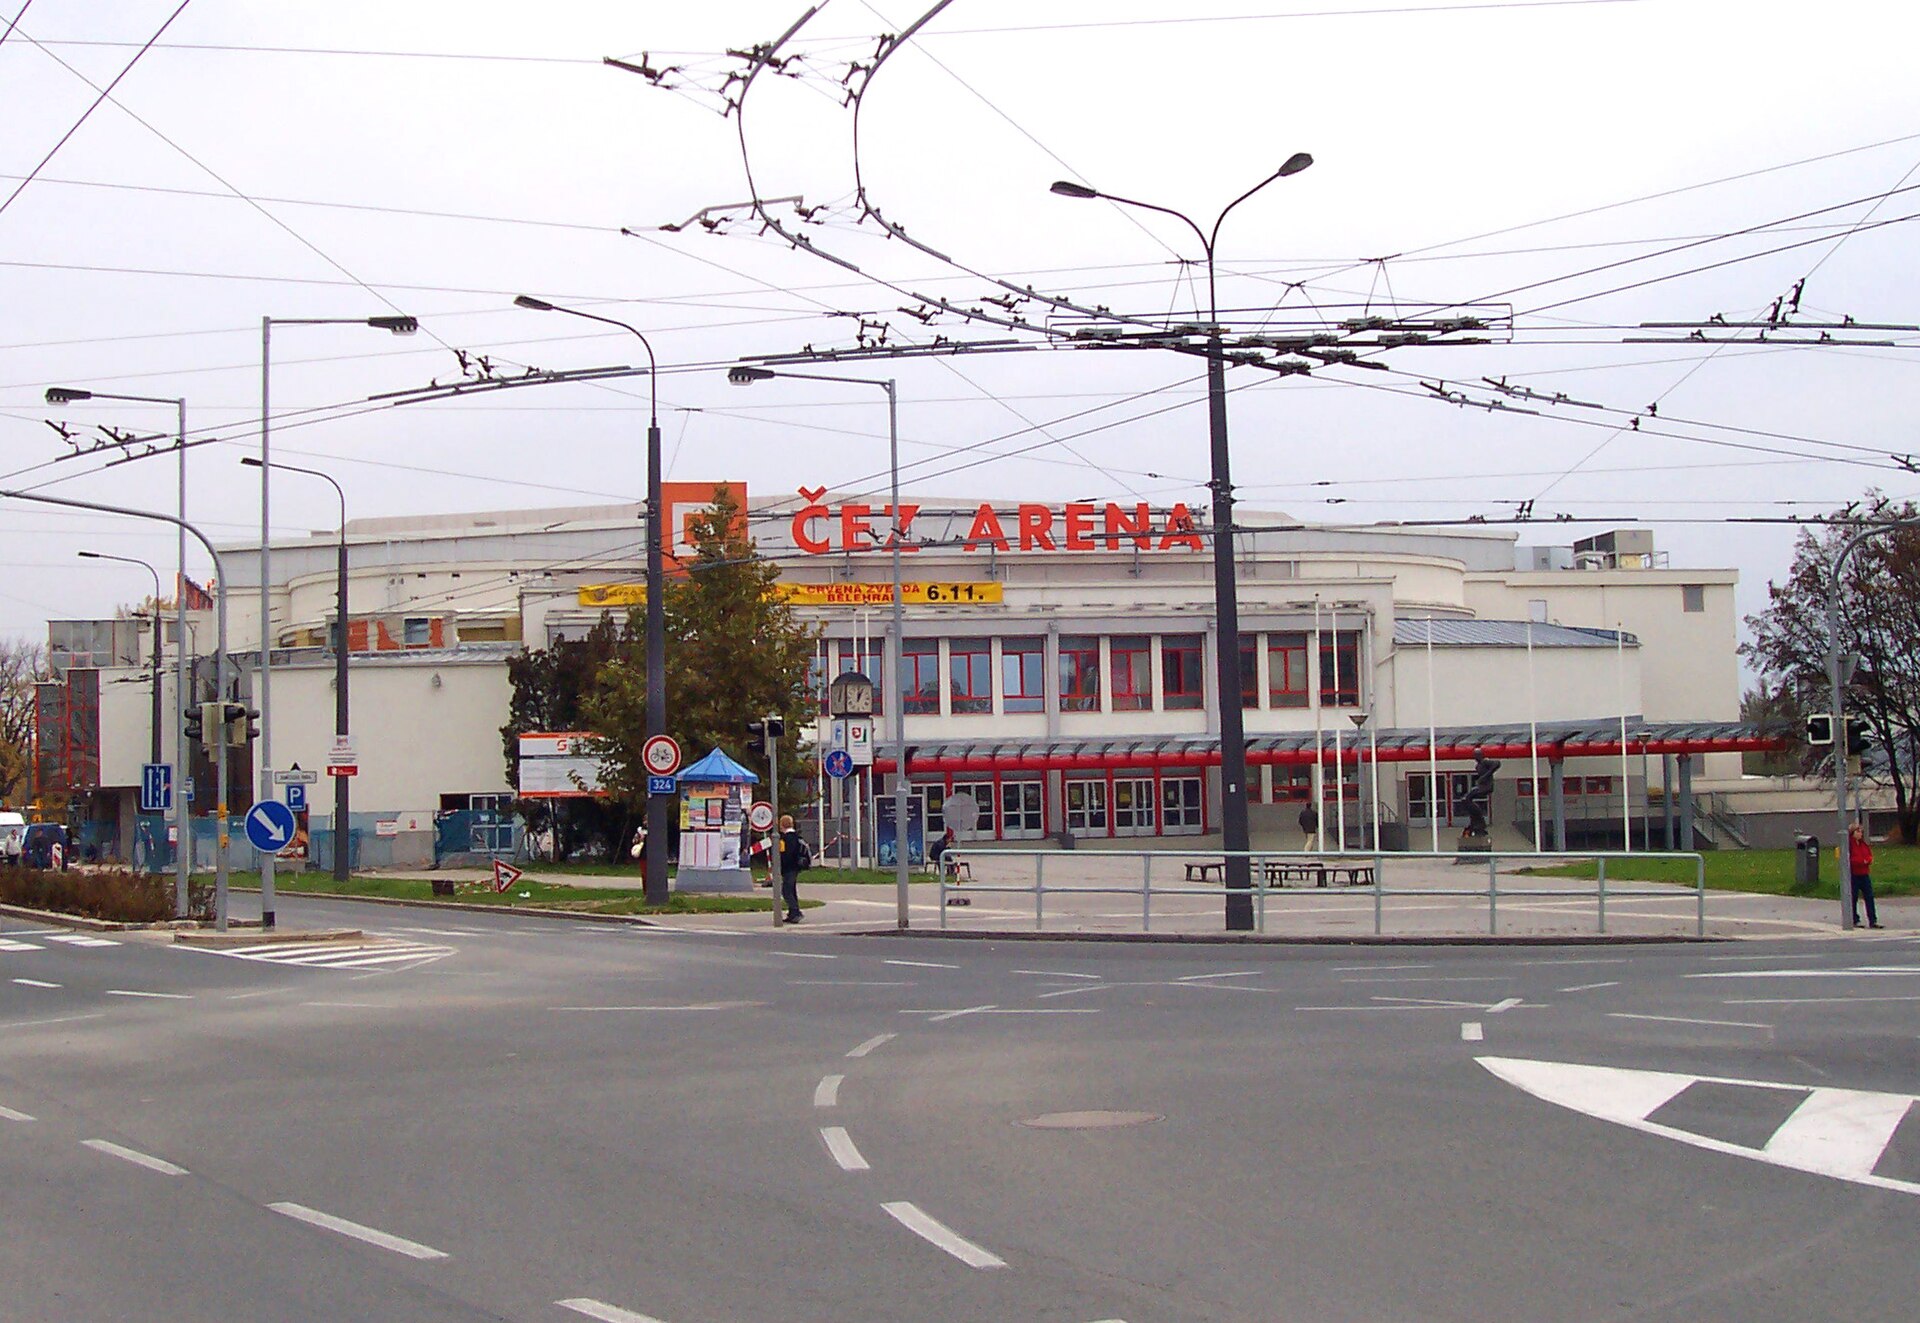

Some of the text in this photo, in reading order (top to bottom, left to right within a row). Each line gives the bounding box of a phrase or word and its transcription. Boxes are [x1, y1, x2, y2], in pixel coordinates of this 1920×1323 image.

[792, 485, 1205, 554] ČEZ ARENA
[866, 584, 920, 593] ZVEDA
[927, 585, 984, 601] 6.11.
[653, 779, 671, 790] 324
[289, 787, 301, 804] P
